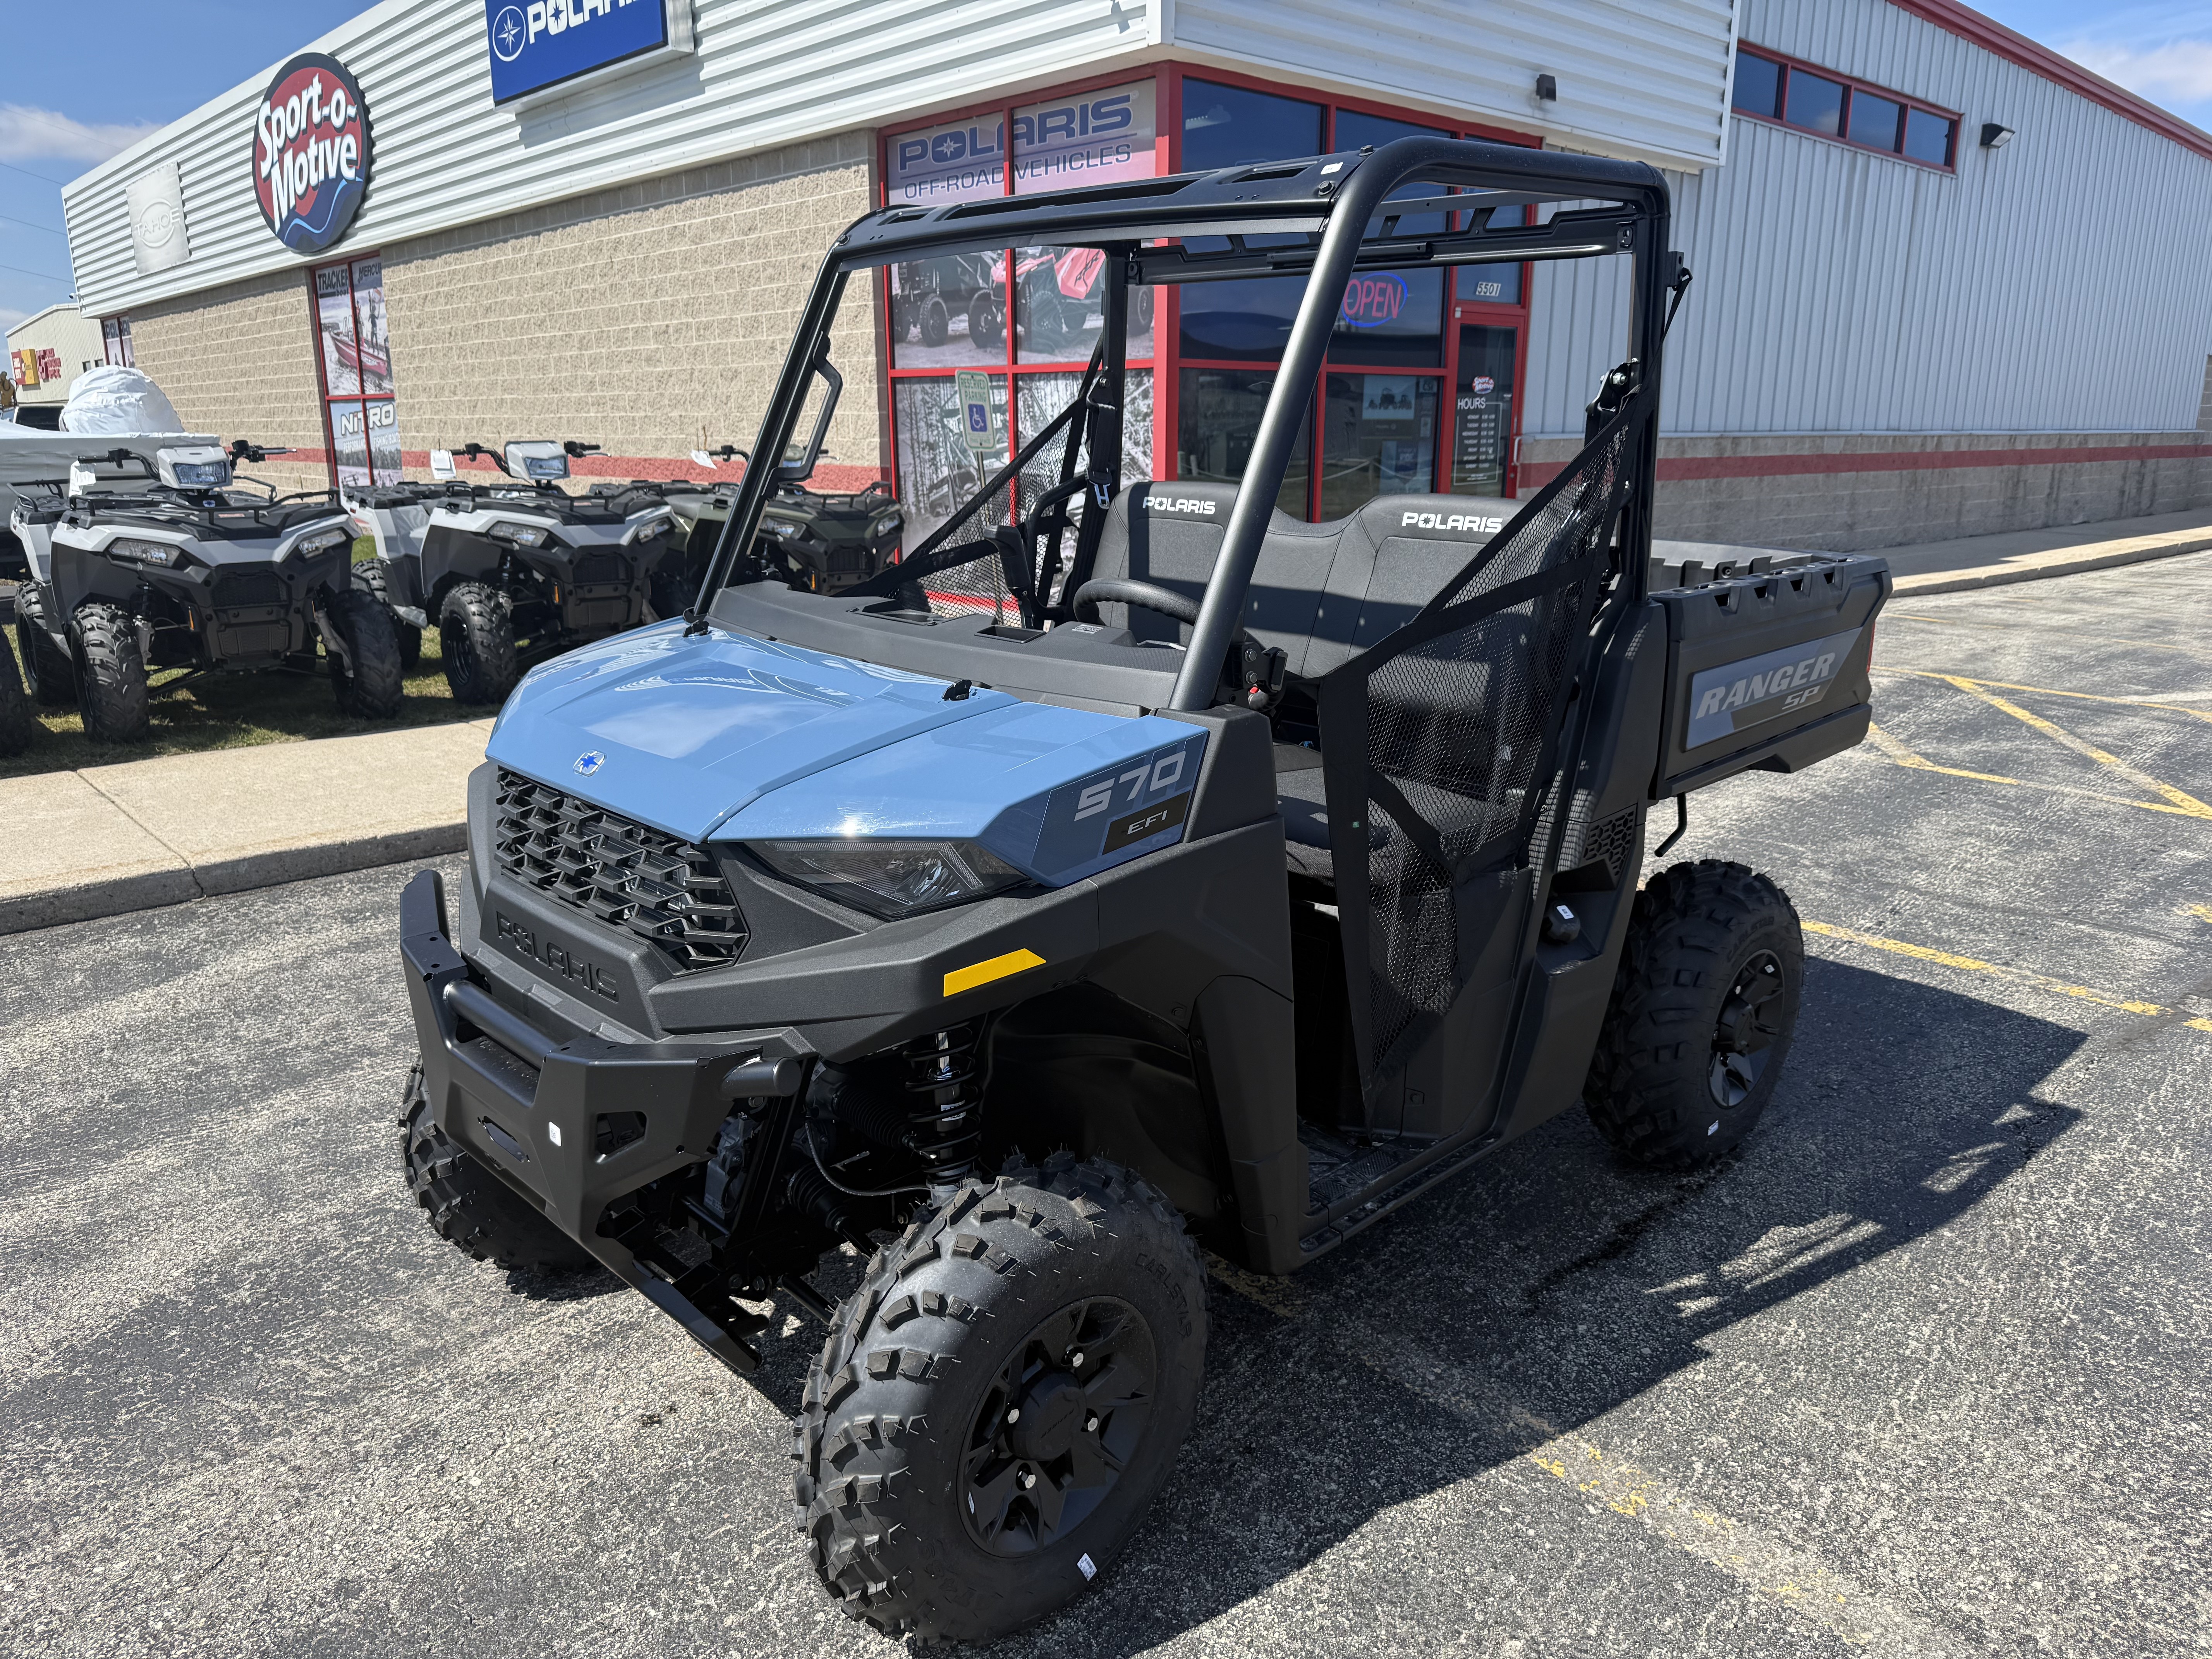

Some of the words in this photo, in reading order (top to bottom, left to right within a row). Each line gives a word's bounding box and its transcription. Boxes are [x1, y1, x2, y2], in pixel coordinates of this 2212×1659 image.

[899, 93, 1132, 171] POLARIS
[271, 134, 357, 235] Motive
[905, 167, 1004, 199] OFF-ROAD
[1015, 144, 1131, 180] VEHICLES
[134, 207, 180, 237] TAHOE
[1343, 279, 1401, 318] OPEN
[1477, 283, 1500, 295] 5501
[961, 377, 986, 390] RESERVED
[965, 390, 986, 402] PARKING
[1457, 397, 1486, 410] HOURS
[1142, 496, 1216, 515] POLARIS
[1401, 512, 1503, 533] POLARIS
[1695, 652, 1835, 719] RANGER
[1782, 685, 1820, 710] SP
[1074, 750, 1186, 821] 570
[1127, 810, 1168, 835] EFI
[496, 910, 619, 1004] POLARIS
[1135, 1252, 1192, 1338] CARLSTAR
